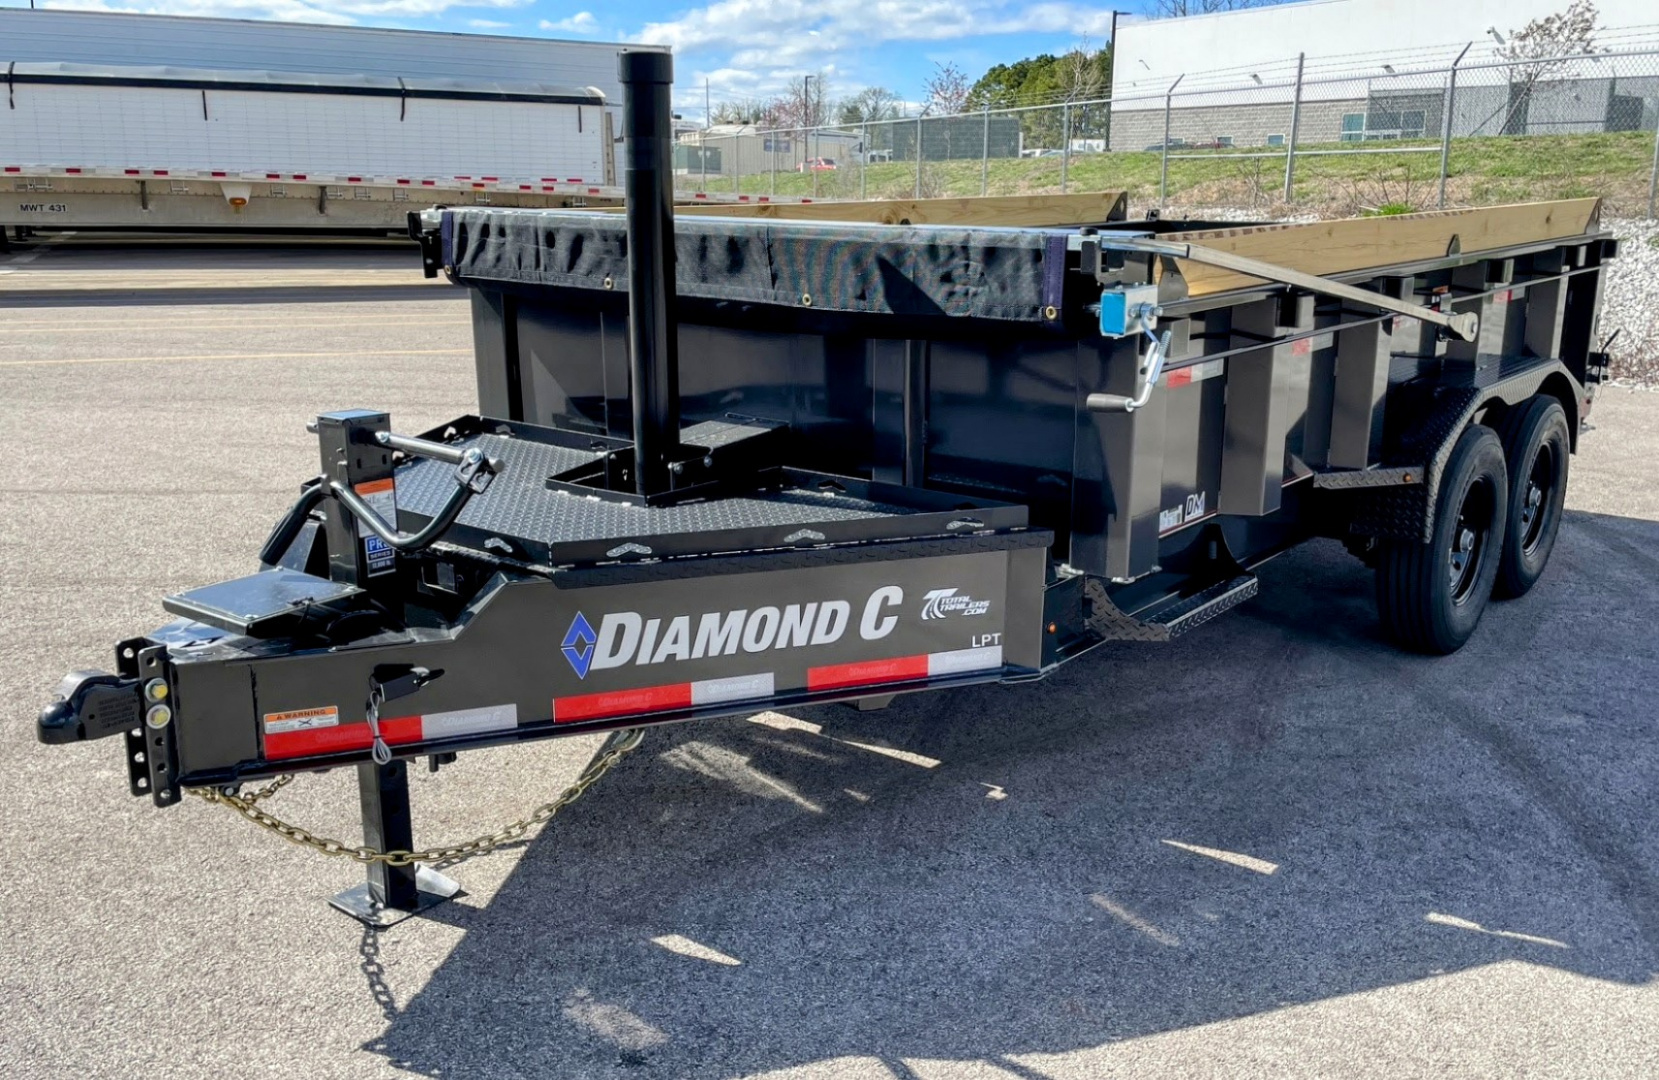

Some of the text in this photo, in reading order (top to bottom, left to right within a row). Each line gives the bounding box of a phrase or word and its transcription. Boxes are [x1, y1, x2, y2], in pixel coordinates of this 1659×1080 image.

[20, 204, 66, 212] MWT 431
[1185, 491, 1206, 519] DM
[370, 552, 391, 560] SERIES
[940, 600, 991, 611] TRAILERS
[941, 596, 972, 605] TOTAL
[590, 586, 904, 670] DIAMOND C
[972, 632, 1001, 647] LPT
[285, 709, 326, 720] WARNING
